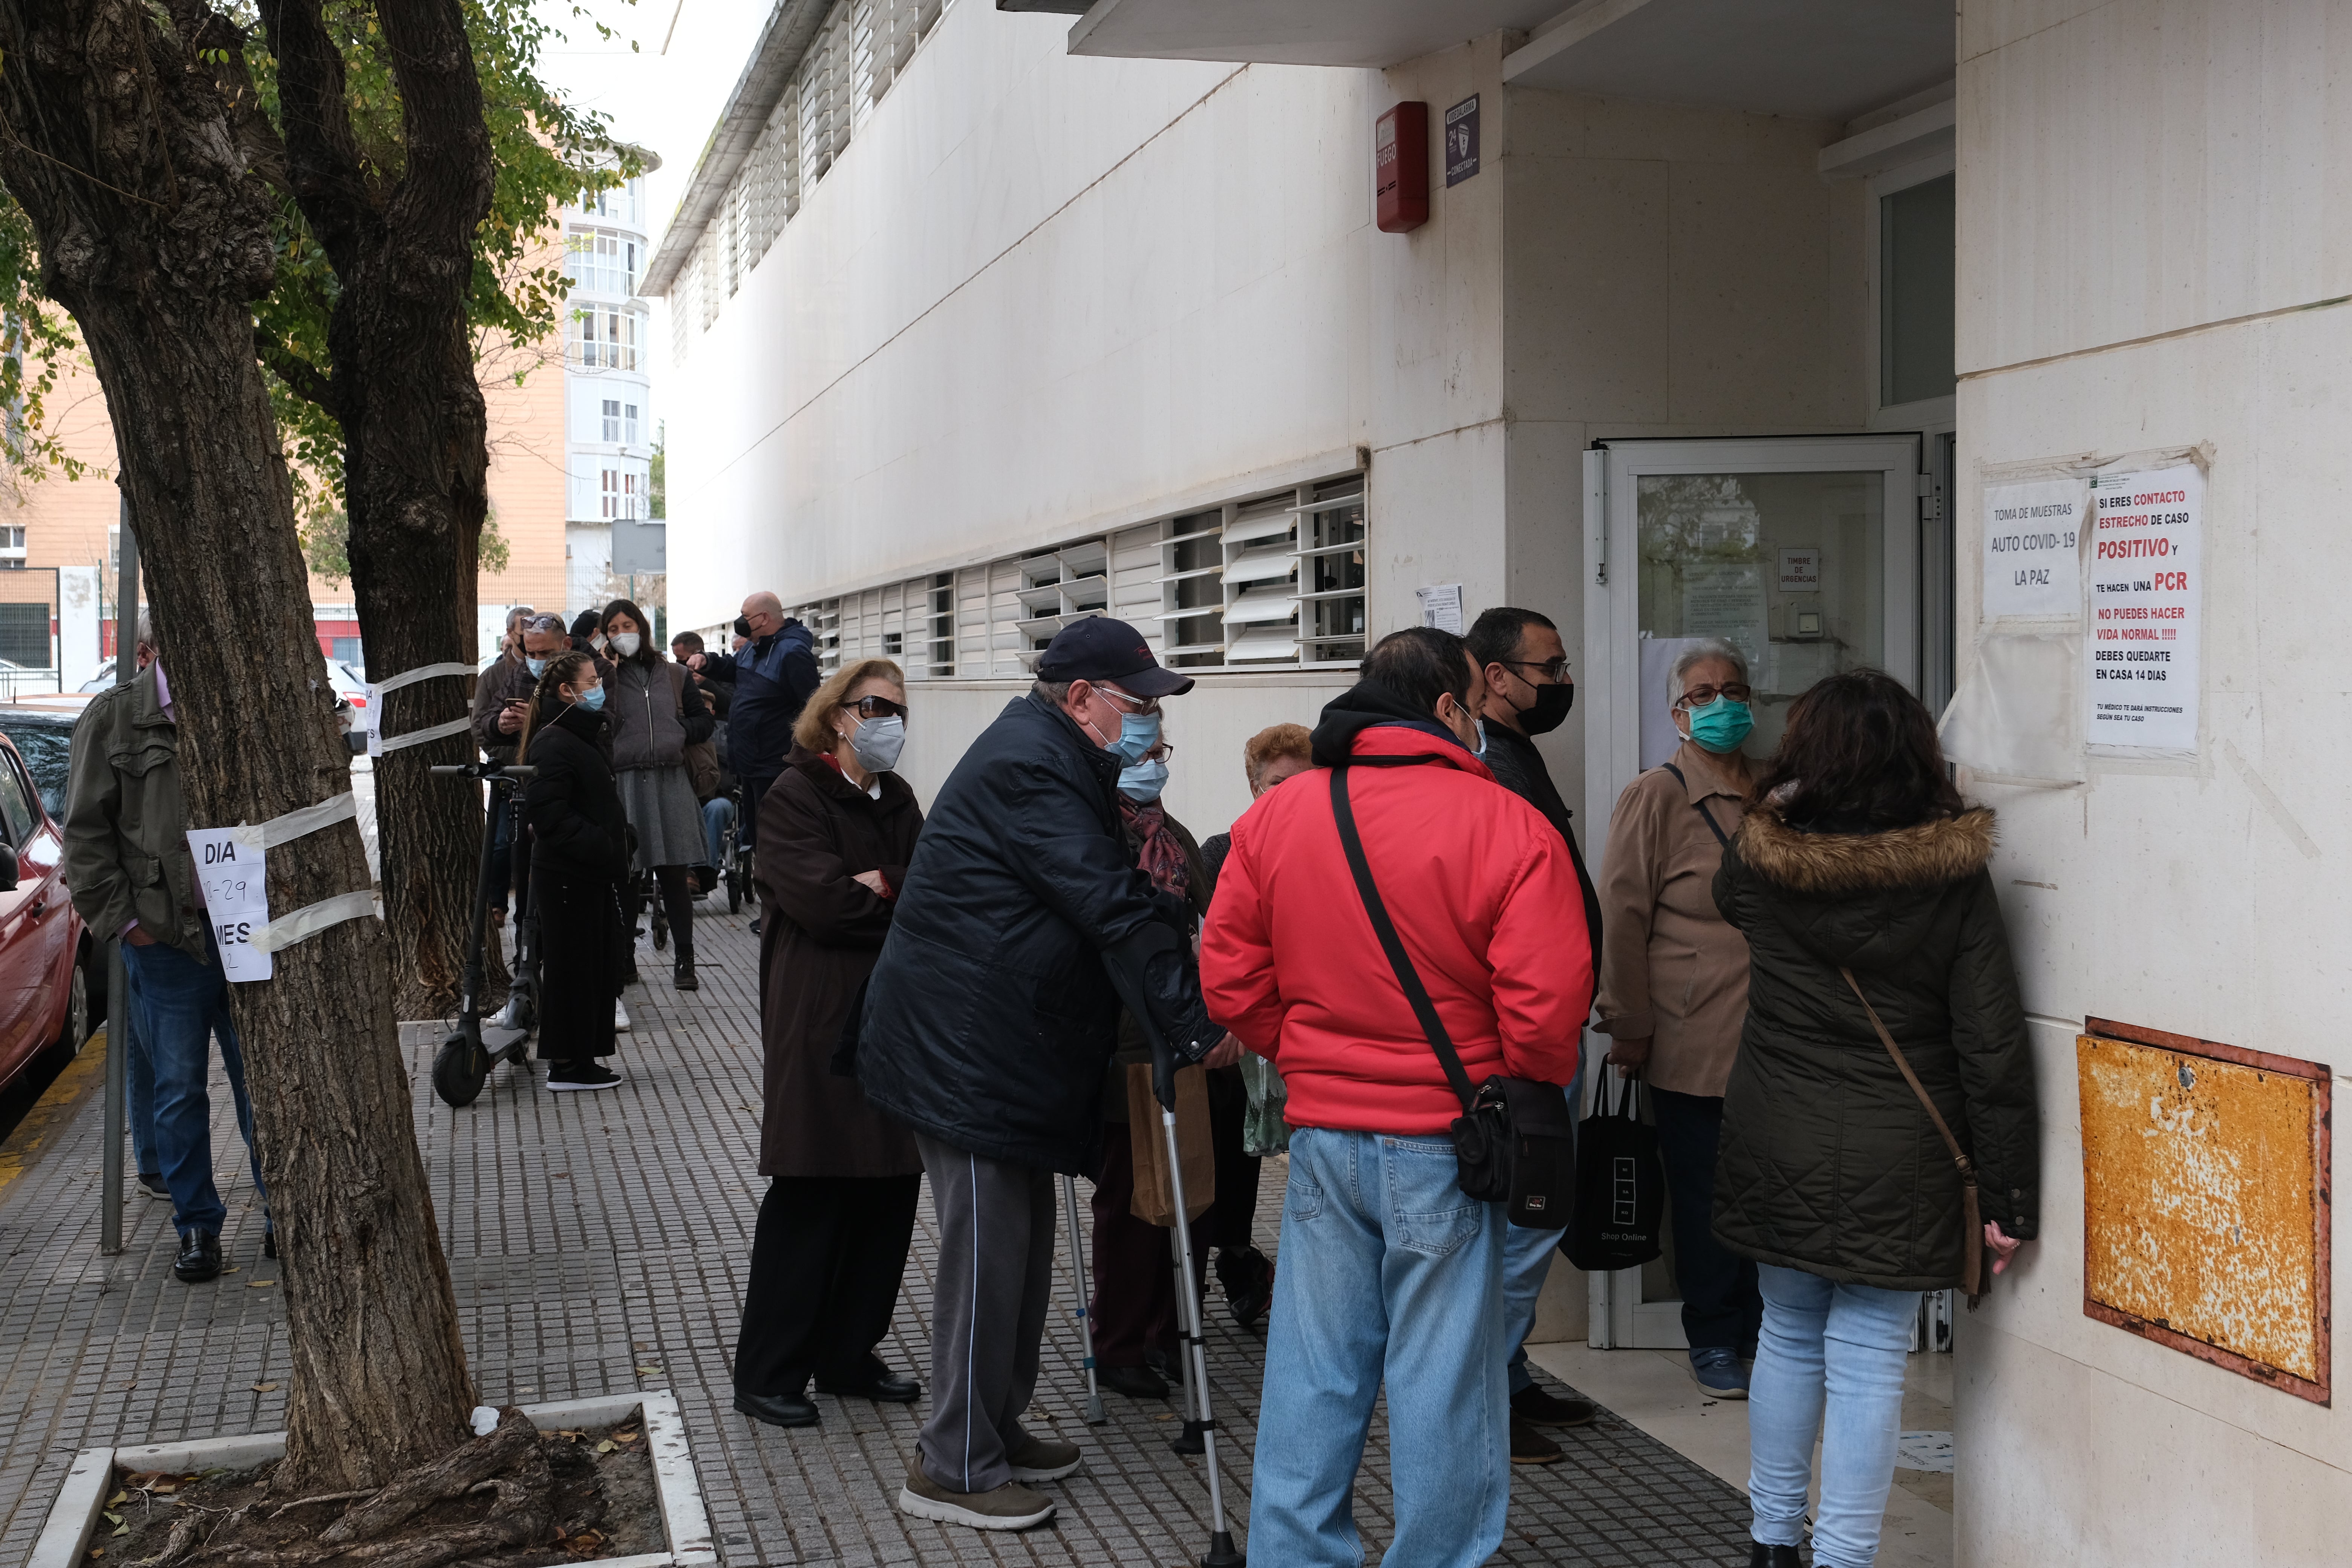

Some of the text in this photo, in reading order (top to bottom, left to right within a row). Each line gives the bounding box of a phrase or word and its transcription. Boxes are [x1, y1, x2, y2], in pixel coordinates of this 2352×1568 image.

[1449, 101, 1474, 122] VIDEOALARMA
[1377, 143, 1396, 169] FUEGO
[1452, 158, 1473, 176] CONECTADA
[2099, 490, 2185, 508] SI ERES CONTACTO
[1994, 503, 2072, 521] TOMA DE MUESTRAS
[2099, 512, 2189, 529] ESTRECHO DE CASO
[1991, 536, 2020, 553] AUTO
[2063, 531, 2075, 548] 19
[2098, 537, 2178, 559] POSITIVO Y
[2015, 569, 2049, 586] LA PAZ
[2096, 571, 2188, 593] TE HACEN UNA PCR
[2098, 607, 2185, 620] NO PUEDES HACER
[2097, 628, 2119, 640] VIDA
[2121, 628, 2159, 640] NORMAL
[2096, 650, 2170, 662] DEBES QUEDARTE
[2096, 669, 2167, 681] EN CASA 14 DIAS
[2144, 705, 2183, 714] INSTRUCCIONES
[205, 841, 236, 864] DIA
[1601, 1232, 1647, 1241] Shop Online
